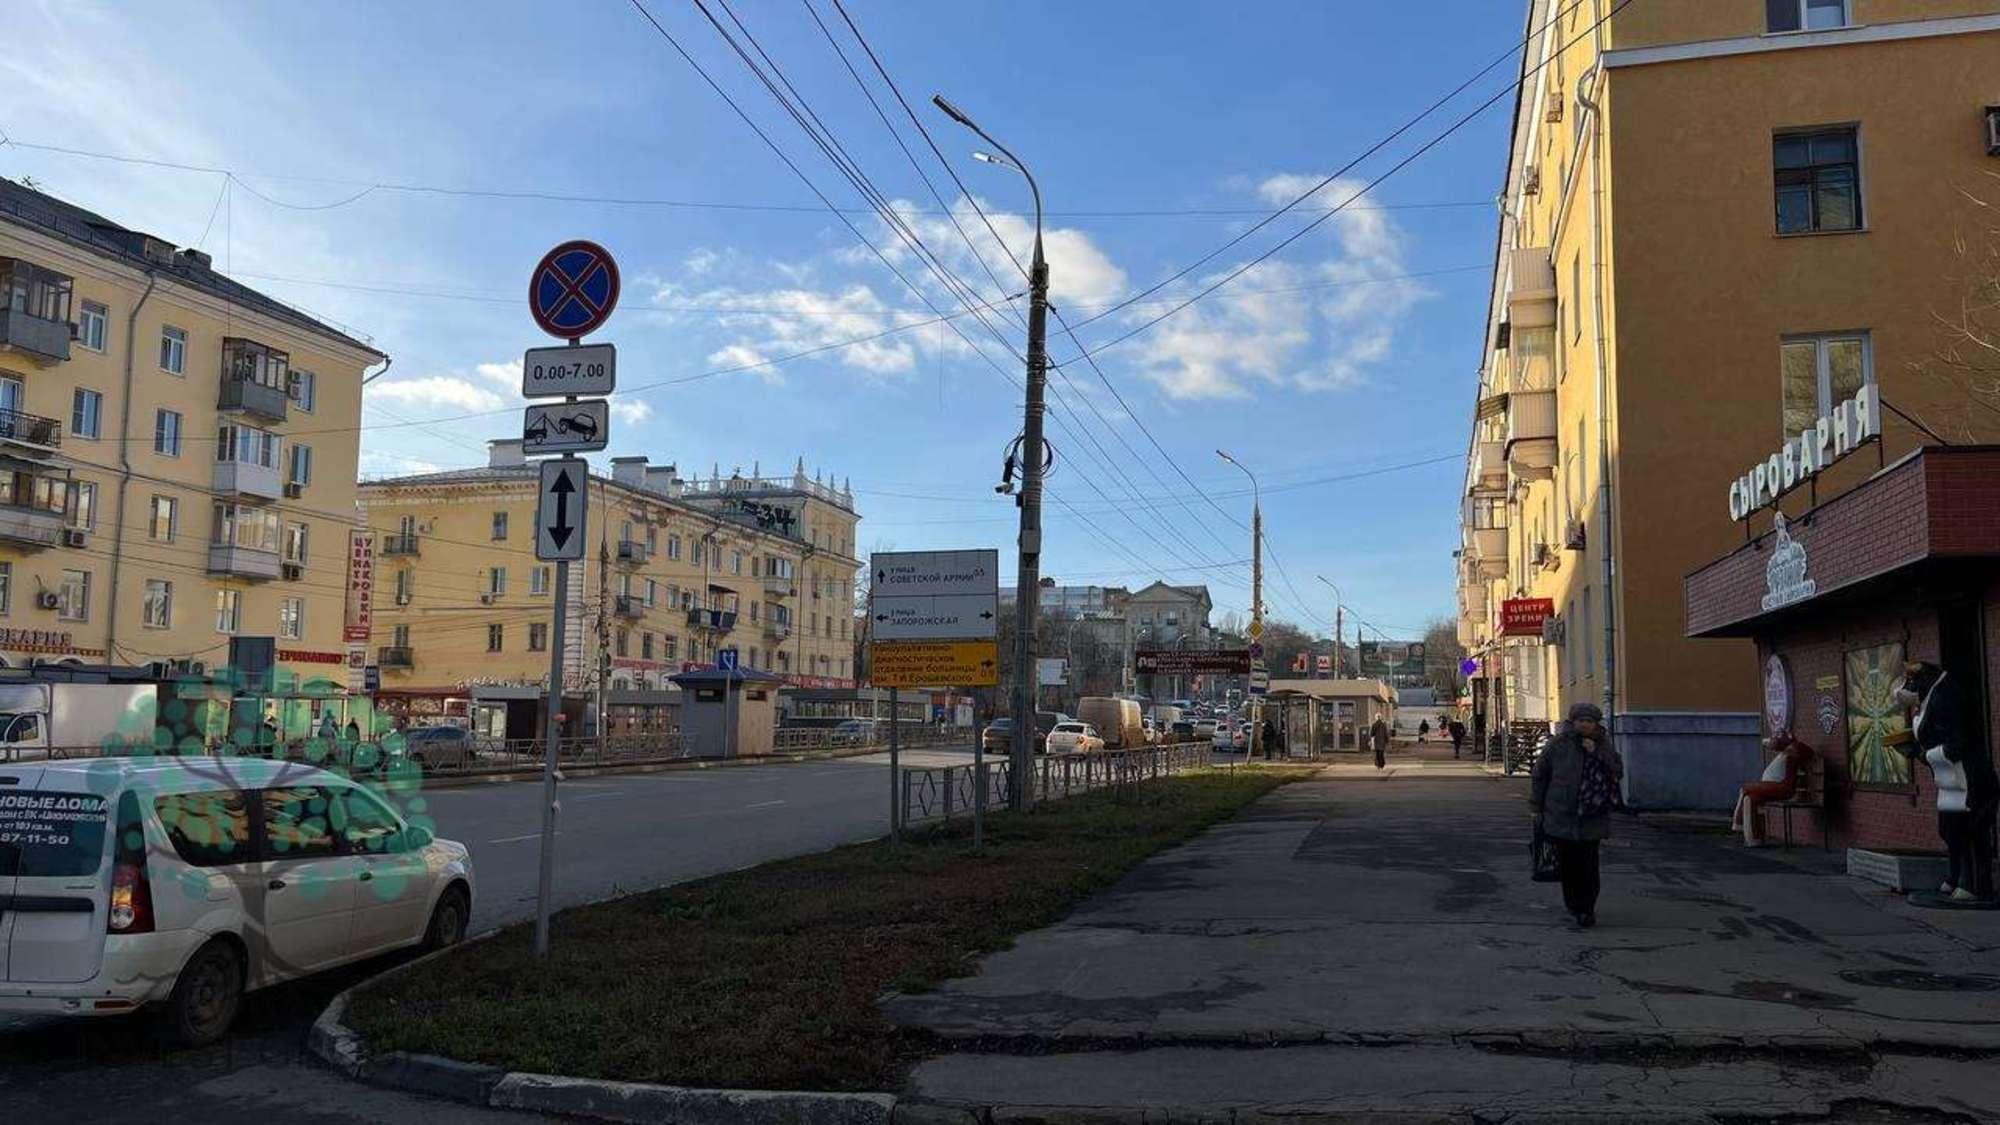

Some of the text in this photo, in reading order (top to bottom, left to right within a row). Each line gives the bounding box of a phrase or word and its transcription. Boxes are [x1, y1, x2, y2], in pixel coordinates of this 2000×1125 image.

[534, 363, 604, 380] 0.00-7.00
[1729, 384, 1880, 521] СЫРОВАРНЯ
[359, 537, 373, 624] УПАКОВКИ
[890, 572, 941, 584] СОВЕТСКОЙ
[1510, 604, 1545, 614] ЦЕНТР
[890, 616, 959, 626] ЗАПОРОЖСКАЯ
[1507, 613, 1545, 623] ЗРЕНИ
